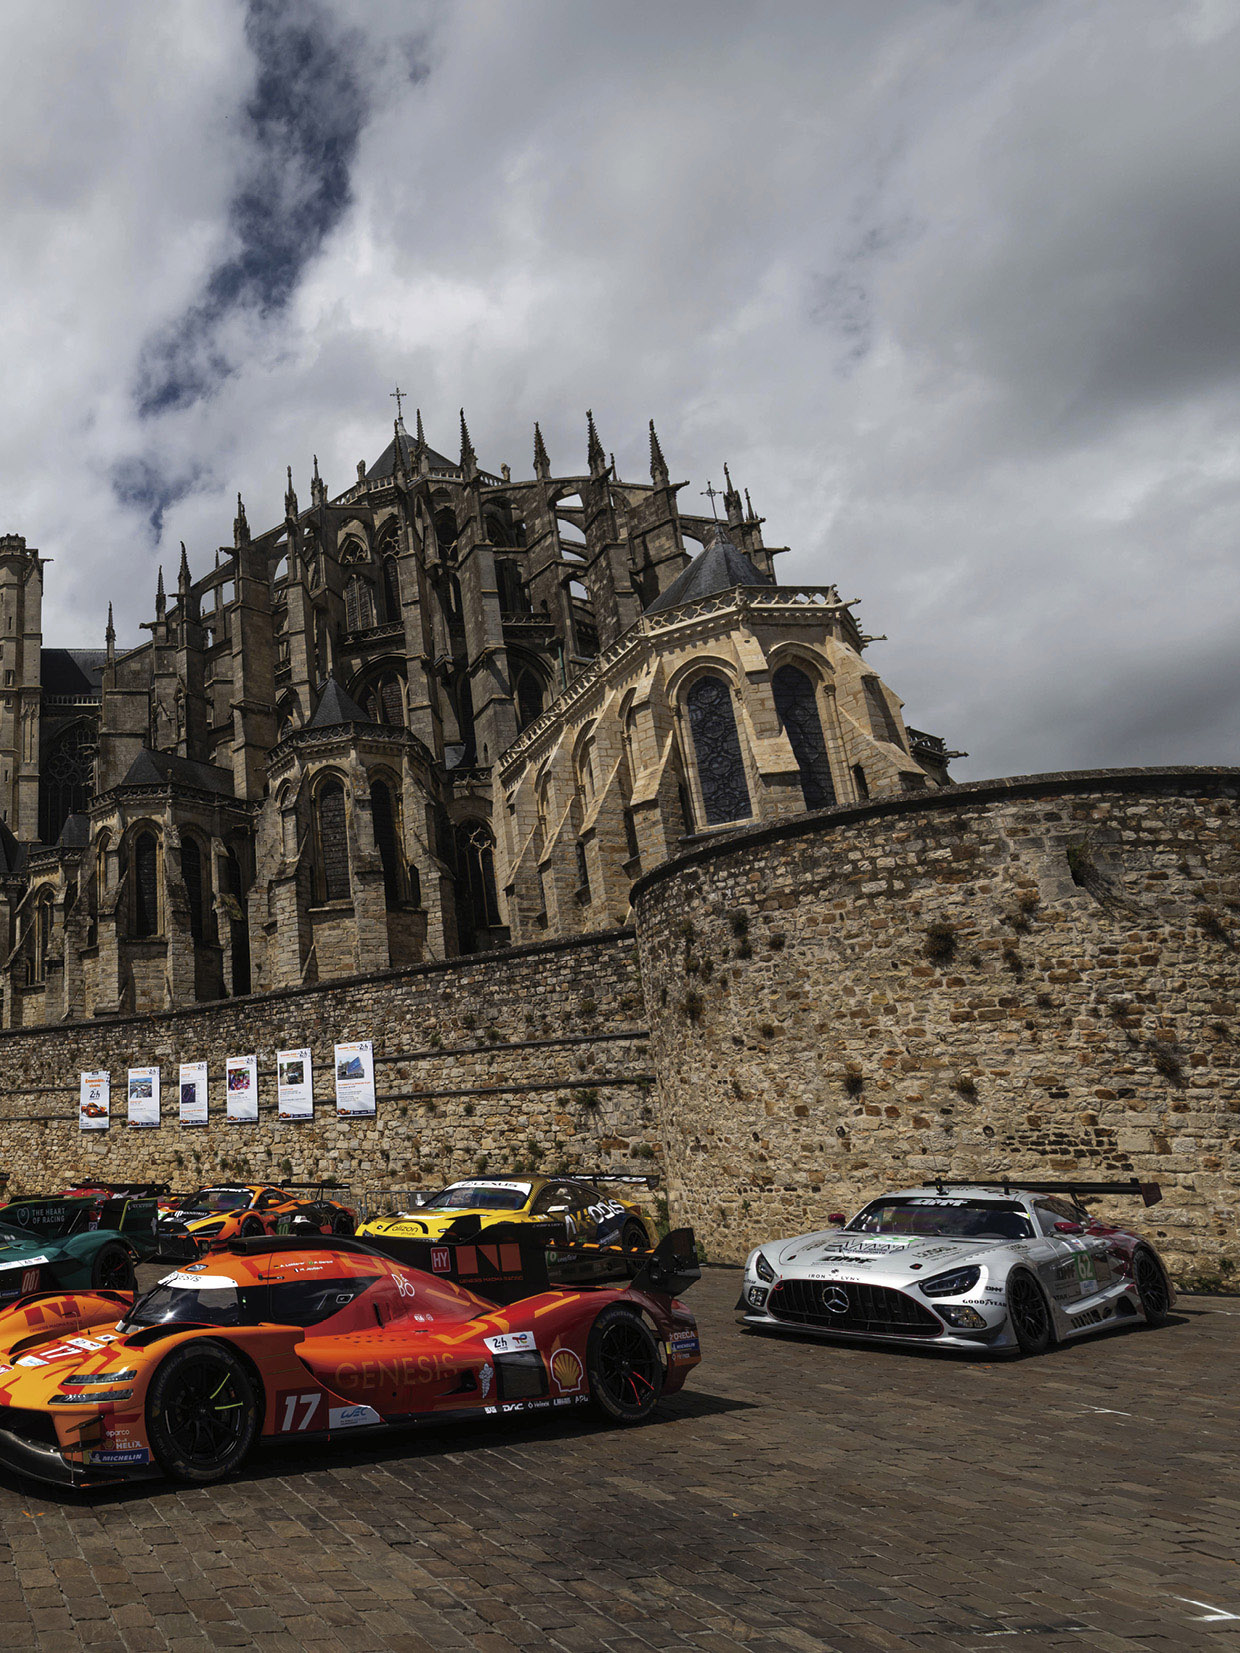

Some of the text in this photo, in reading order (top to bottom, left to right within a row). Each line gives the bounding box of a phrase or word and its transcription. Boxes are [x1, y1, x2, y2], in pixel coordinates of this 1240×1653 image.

[41, 1215, 65, 1223] RACING
[433, 1252, 447, 1267] HY
[1078, 1254, 1093, 1279] 62
[962, 1299, 1007, 1307] GOODYEAR
[674, 1330, 696, 1340] ORECA
[335, 1352, 458, 1390] GENESIS
[281, 1393, 322, 1431] 17
[341, 1407, 369, 1419] WEC
[106, 1429, 130, 1437] sparco
[116, 1441, 142, 1449] HELIX
[102, 1453, 142, 1461] MICHELIN
